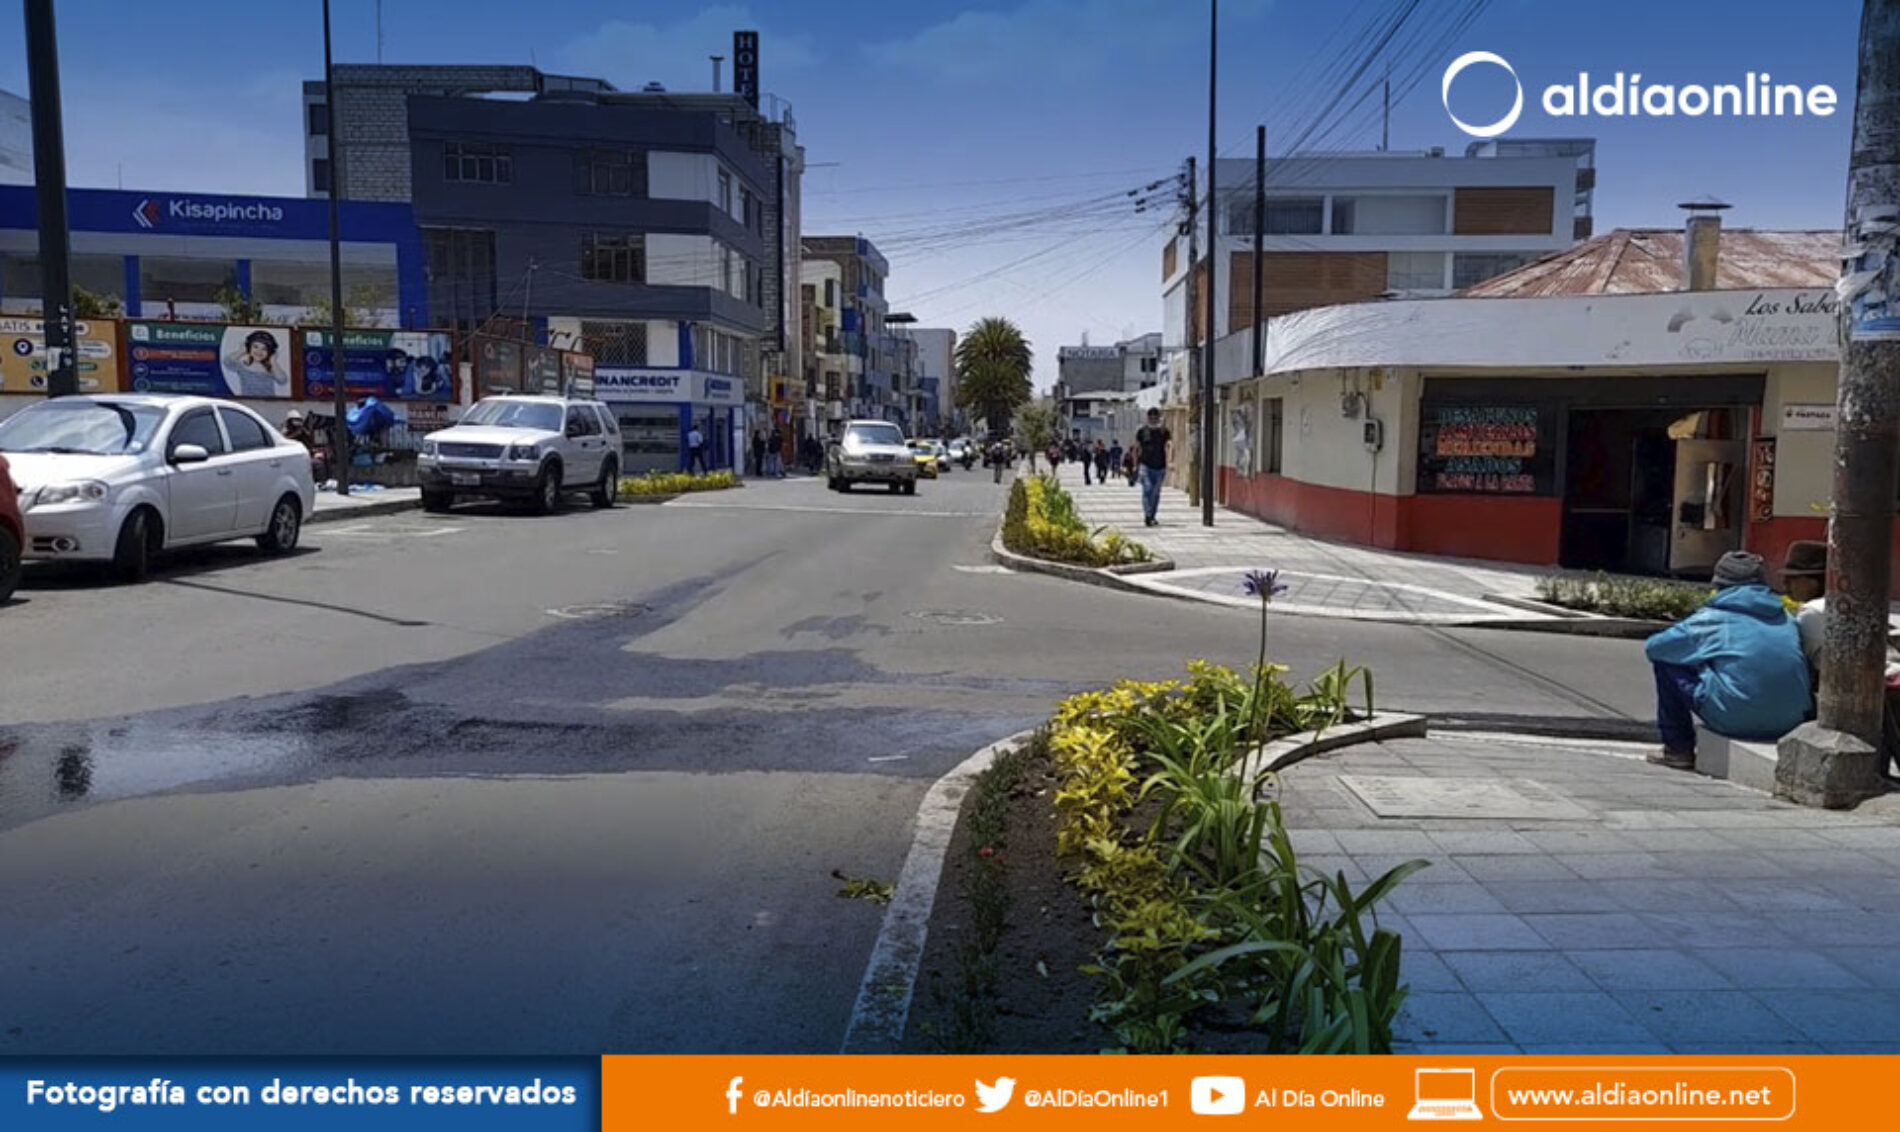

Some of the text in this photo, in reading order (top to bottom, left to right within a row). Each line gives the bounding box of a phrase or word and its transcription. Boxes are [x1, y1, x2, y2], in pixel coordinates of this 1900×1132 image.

[169, 200, 283, 221] Kisapincha
[1745, 292, 1837, 315] Los Sabo
[156, 329, 216, 342] Beneficios
